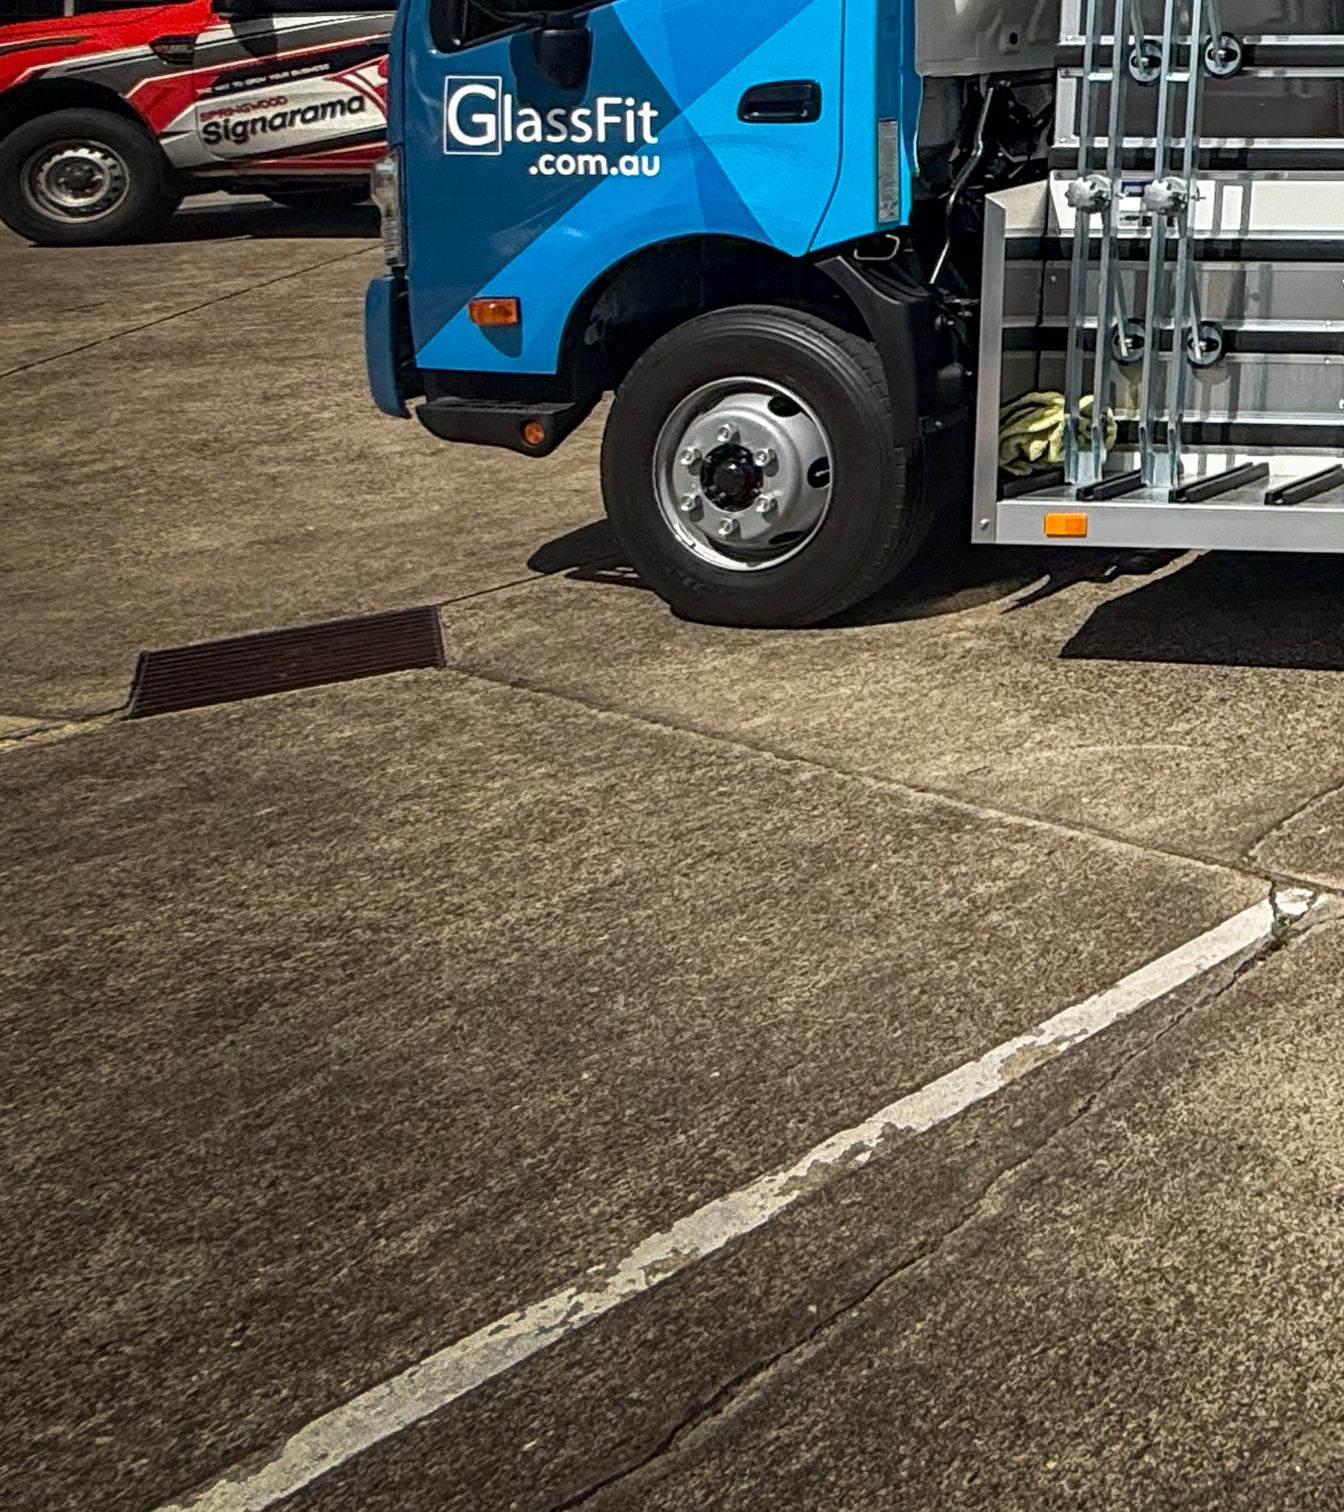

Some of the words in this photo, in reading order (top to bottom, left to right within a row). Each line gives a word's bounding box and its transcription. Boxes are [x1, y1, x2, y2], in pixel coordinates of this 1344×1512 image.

[200, 96, 289, 122] SPRINGWOOD
[203, 95, 365, 146] Signarama
[448, 82, 659, 148] GlassFit
[529, 151, 660, 178] .com.au
